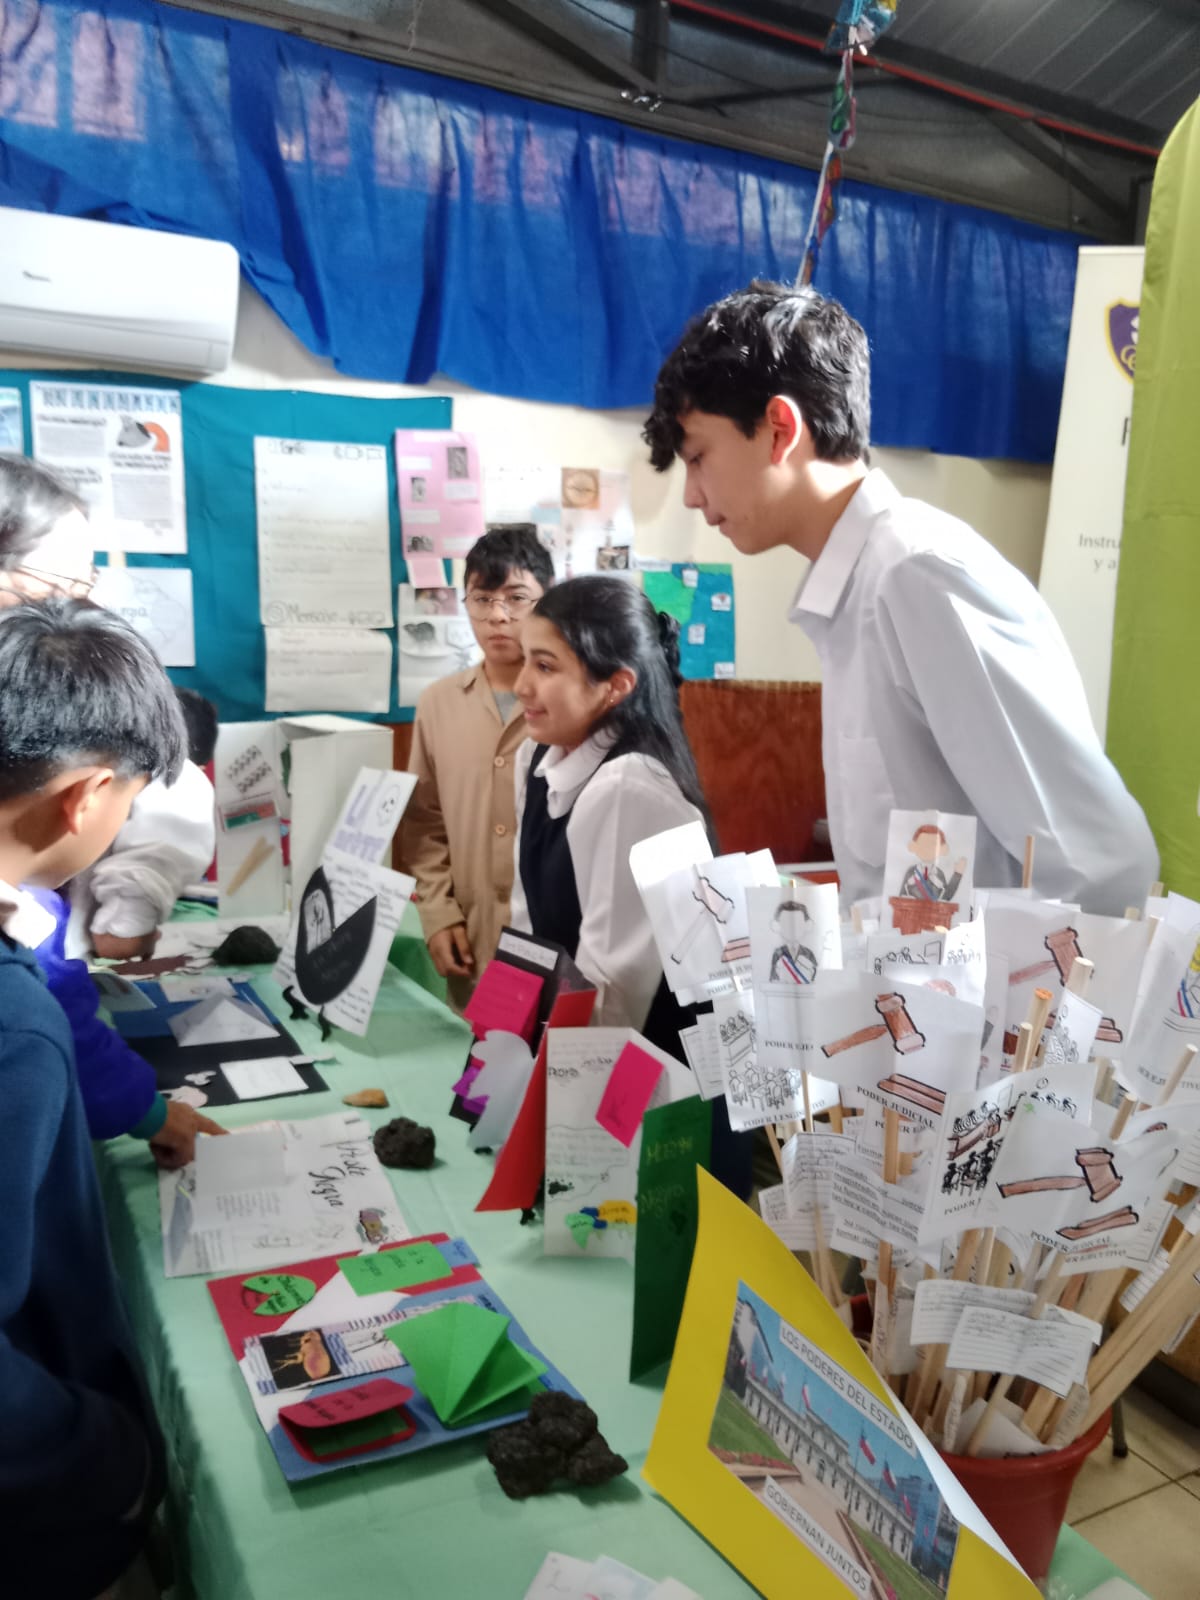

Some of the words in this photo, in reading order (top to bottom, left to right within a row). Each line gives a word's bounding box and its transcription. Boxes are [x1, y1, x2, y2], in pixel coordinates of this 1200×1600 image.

[1079, 533, 1119, 549] Instru
[855, 1085, 888, 1107] PODER
[890, 1102, 935, 1129] JUDICIAL
[874, 1120, 910, 1134] POR
[780, 1327, 802, 1348] LOS
[801, 1341, 846, 1393] PODERES
[846, 1382, 868, 1411] DEL
[869, 1397, 915, 1450] ESTADO
[766, 1483, 827, 1552] GOBIERNAN
[825, 1547, 869, 1592] JUNTOS
